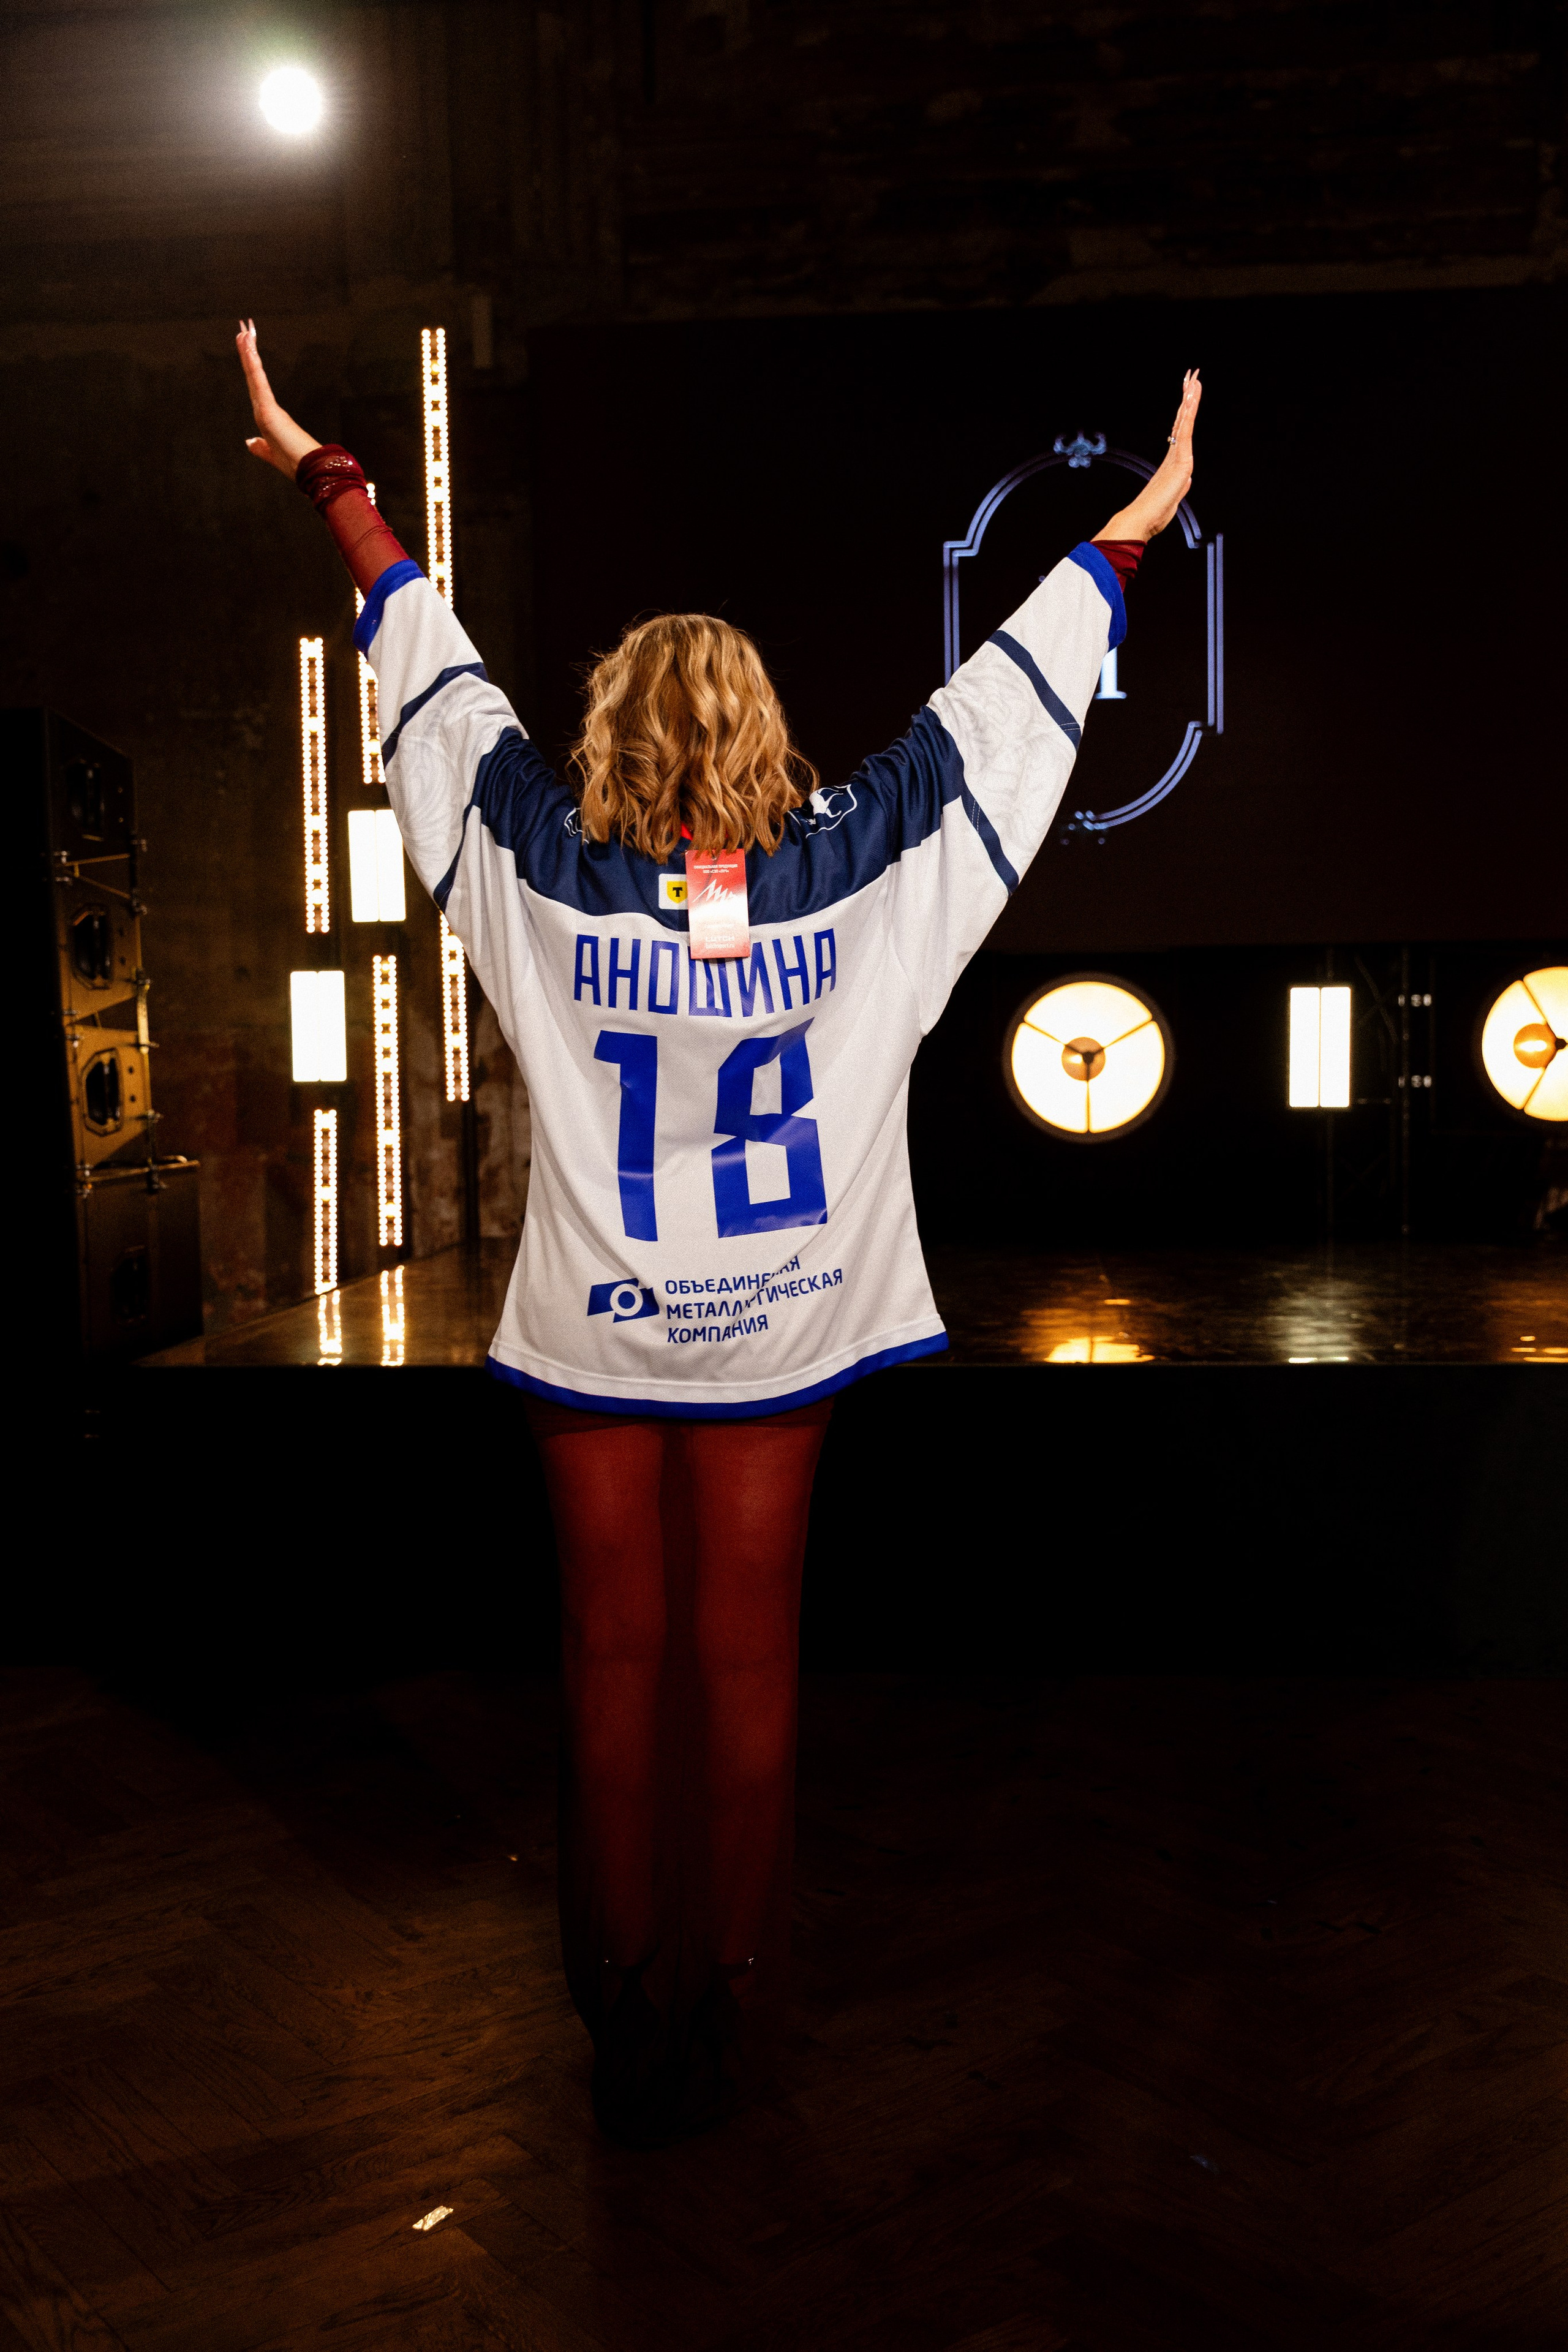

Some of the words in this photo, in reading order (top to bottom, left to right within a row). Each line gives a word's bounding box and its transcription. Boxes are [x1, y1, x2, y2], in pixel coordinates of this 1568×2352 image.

[574, 928, 836, 1018] АНОШИНА
[594, 1017, 828, 1242] 18
[666, 1268, 842, 1319] МЕТАЛЛГИЧЕСКАЯ
[667, 1314, 768, 1344] КОМПАНИЯ
